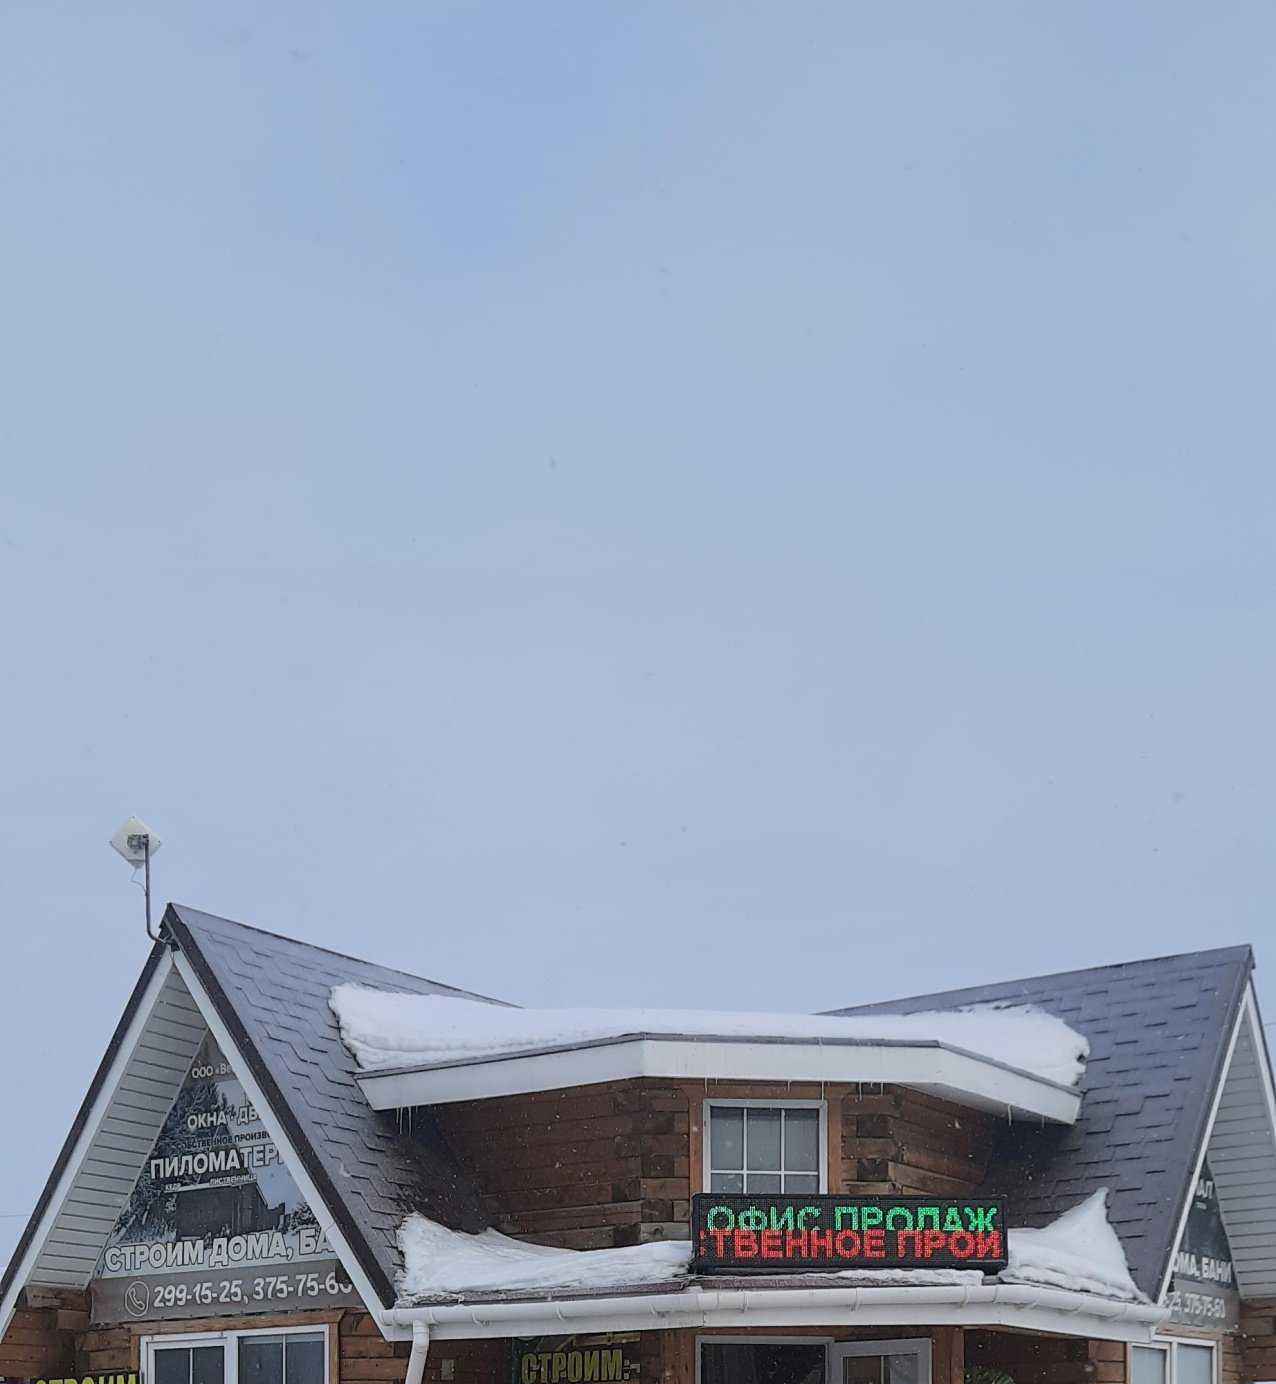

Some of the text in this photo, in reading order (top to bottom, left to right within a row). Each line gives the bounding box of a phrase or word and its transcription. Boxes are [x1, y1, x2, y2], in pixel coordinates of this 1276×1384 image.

[192, 1065, 213, 1079] ООО
[187, 1105, 261, 1130] ОКНА ДВ
[150, 1143, 284, 1180] ПИЛОМАТЕР
[706, 1204, 999, 1231] ОФИС ПРОДАЖ
[105, 1239, 204, 1272] СТРОИМ
[209, 1231, 293, 1269] ДОМА,
[1202, 1255, 1232, 1283] БАНИ
[153, 1280, 248, 1308] 299-15-25,
